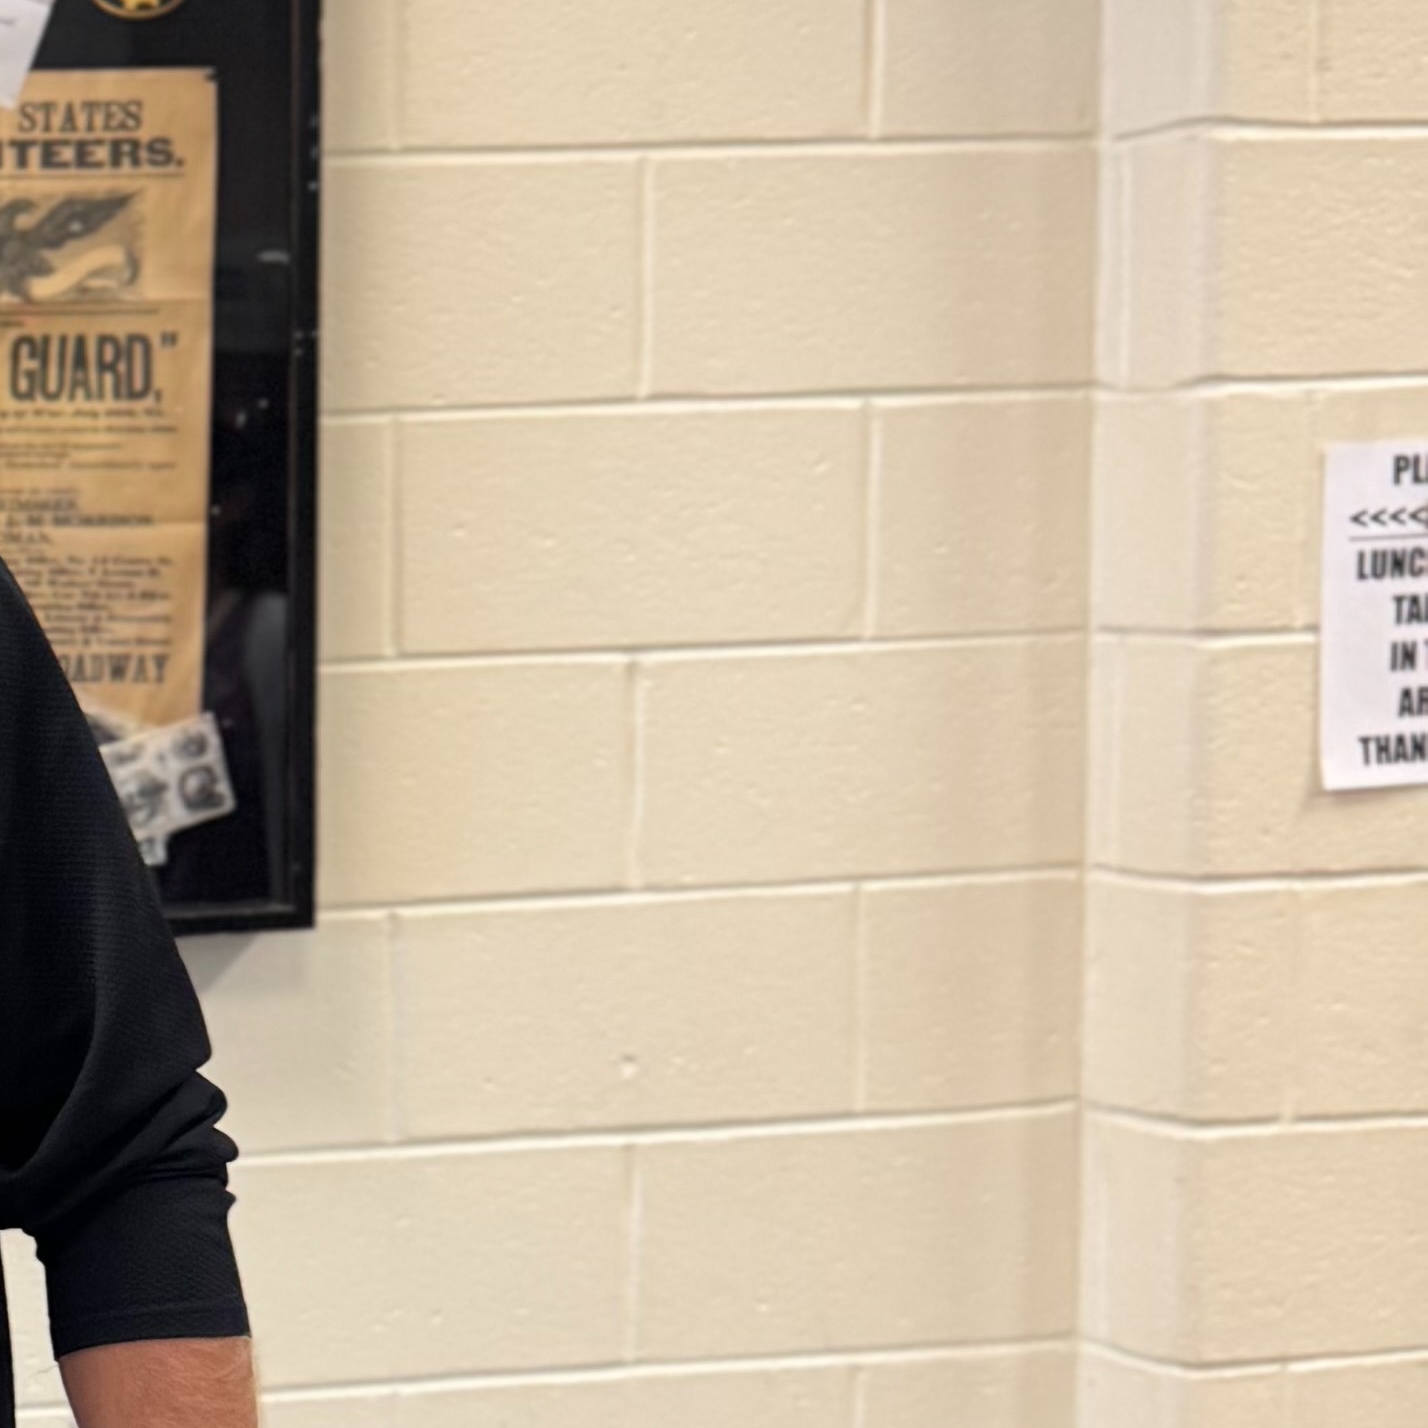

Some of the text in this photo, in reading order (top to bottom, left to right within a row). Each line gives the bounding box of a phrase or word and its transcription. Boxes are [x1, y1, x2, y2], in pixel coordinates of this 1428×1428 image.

[17, 100, 143, 133] STATES
[1392, 454, 1428, 486] PL
[1392, 592, 1428, 626] TA
[1390, 640, 1418, 673] IN
